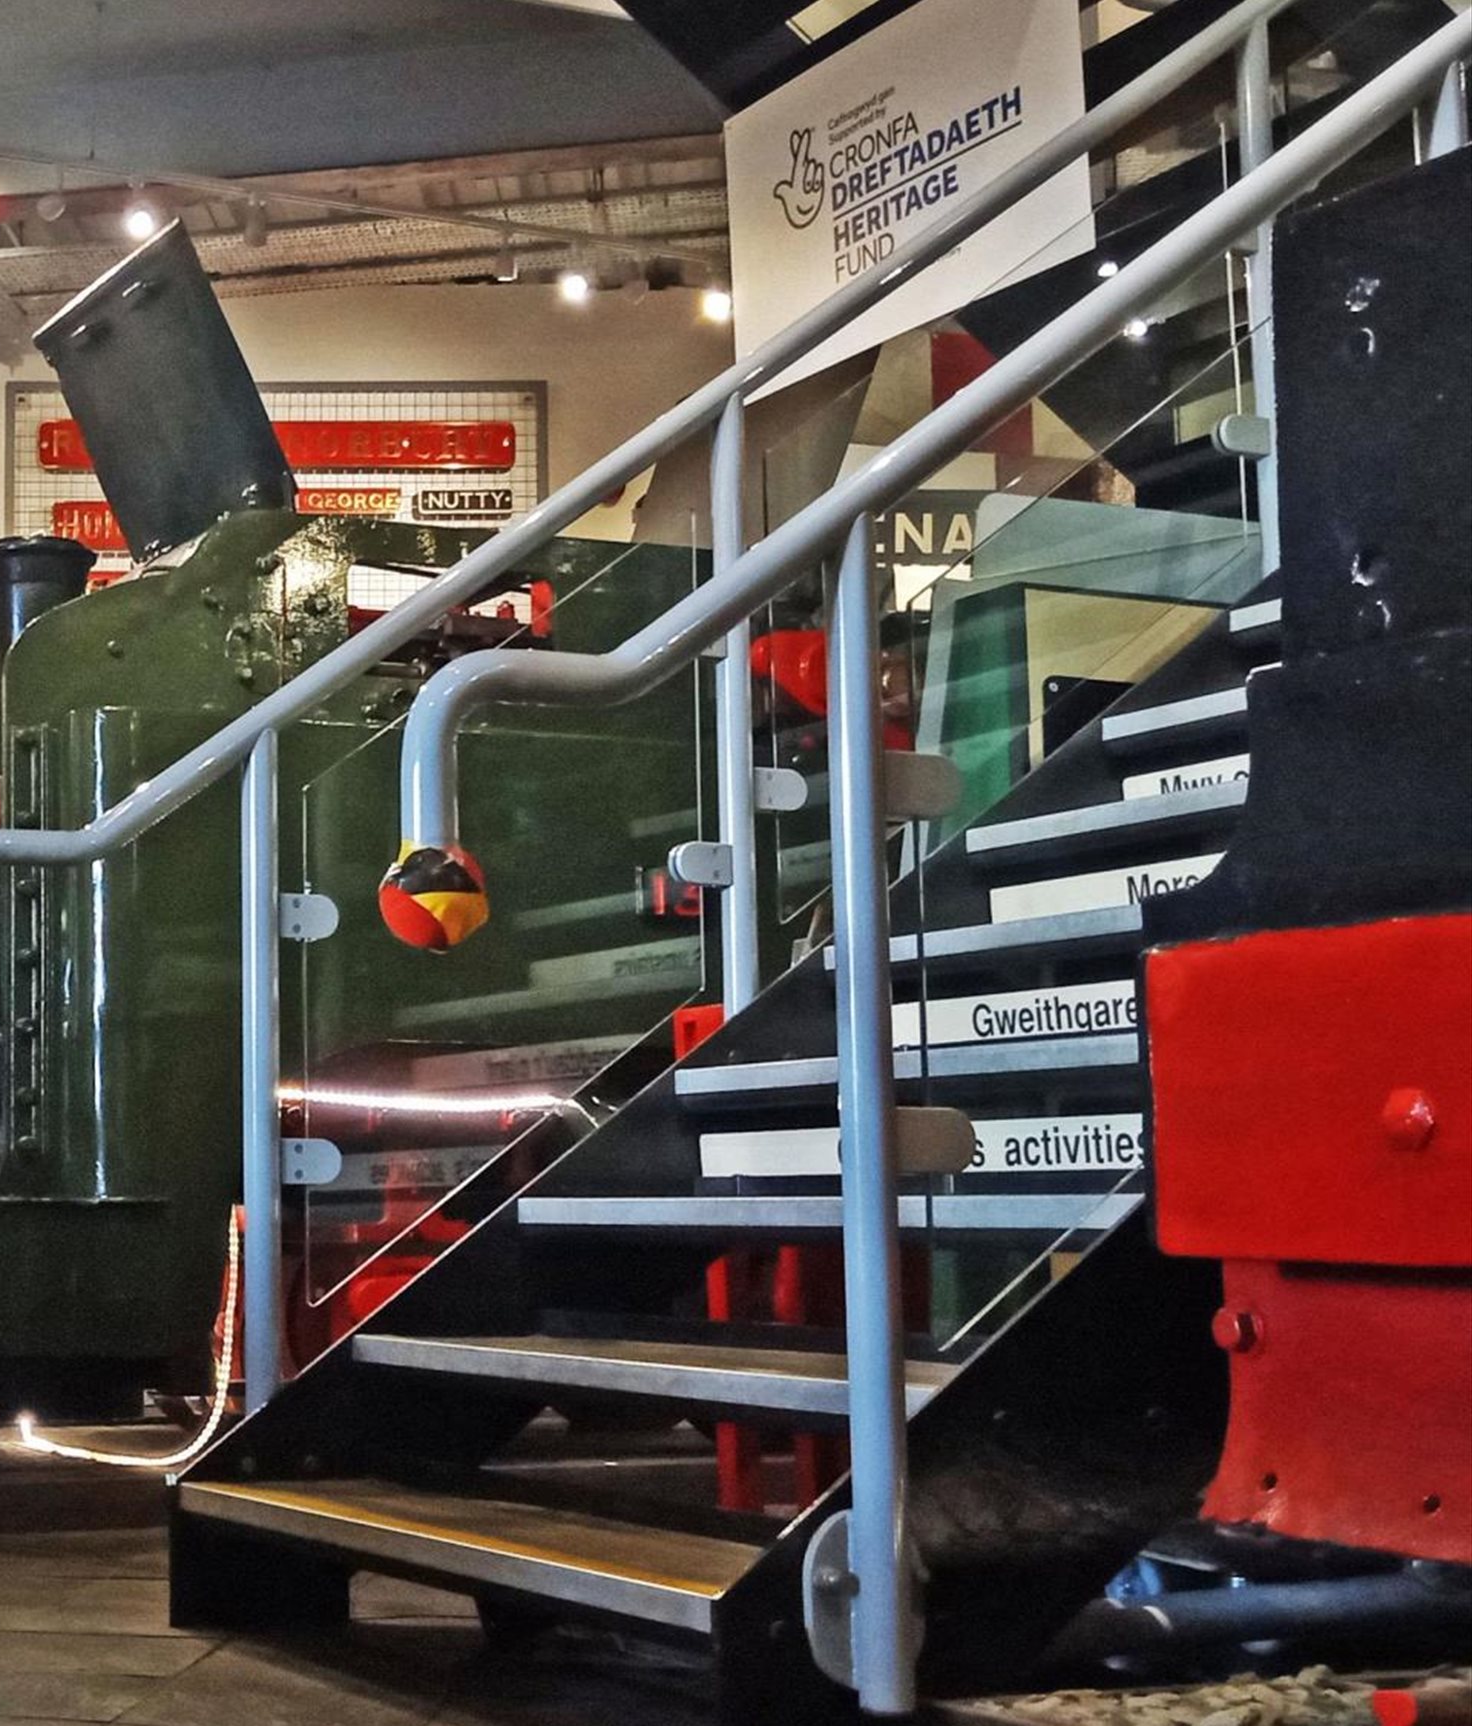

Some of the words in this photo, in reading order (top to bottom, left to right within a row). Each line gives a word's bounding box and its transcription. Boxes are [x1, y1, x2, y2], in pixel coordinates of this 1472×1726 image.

[829, 110, 919, 179] CRONFA
[831, 86, 1021, 212] DREFTADAETH
[833, 164, 960, 253] HERITAGE
[834, 232, 895, 284] FUND
[307, 491, 399, 510] GEORGE
[427, 491, 504, 509] NUTTY
